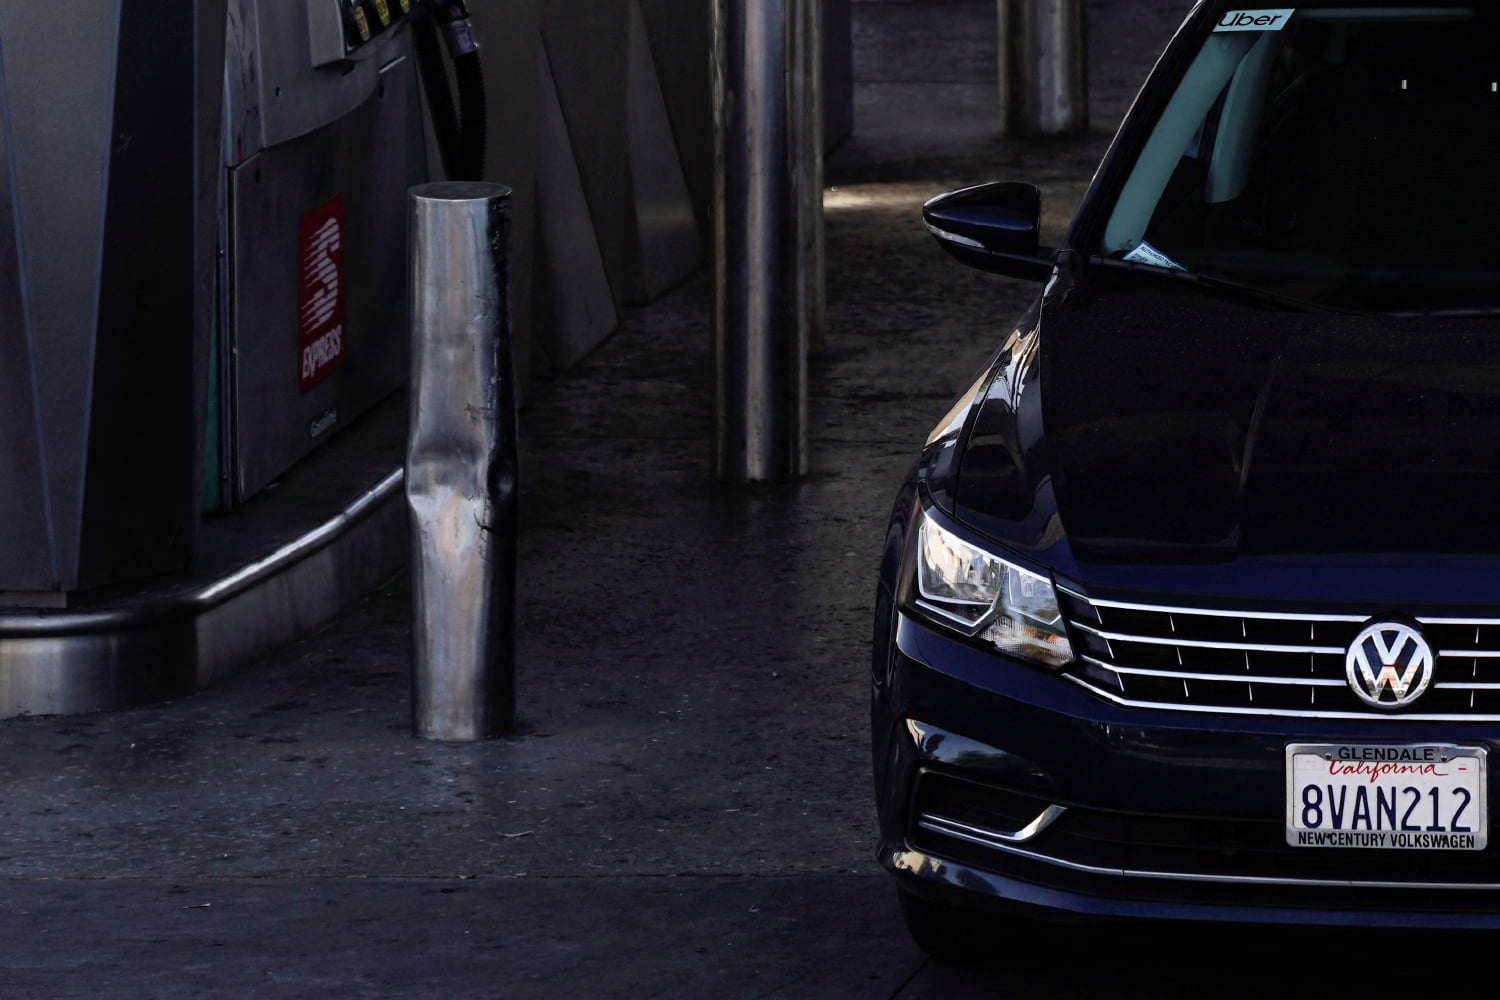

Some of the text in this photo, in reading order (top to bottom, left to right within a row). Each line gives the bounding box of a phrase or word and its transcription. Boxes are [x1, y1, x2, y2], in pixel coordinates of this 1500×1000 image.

[1218, 12, 1282, 27] Uber
[301, 322, 343, 380] EXPRESS
[1337, 746, 1435, 761] GLENDALE
[1329, 759, 1449, 783] California
[1301, 783, 1472, 833] 8VAN212
[1298, 831, 1475, 849] NEW CENTURY VOLKSWAGEN
